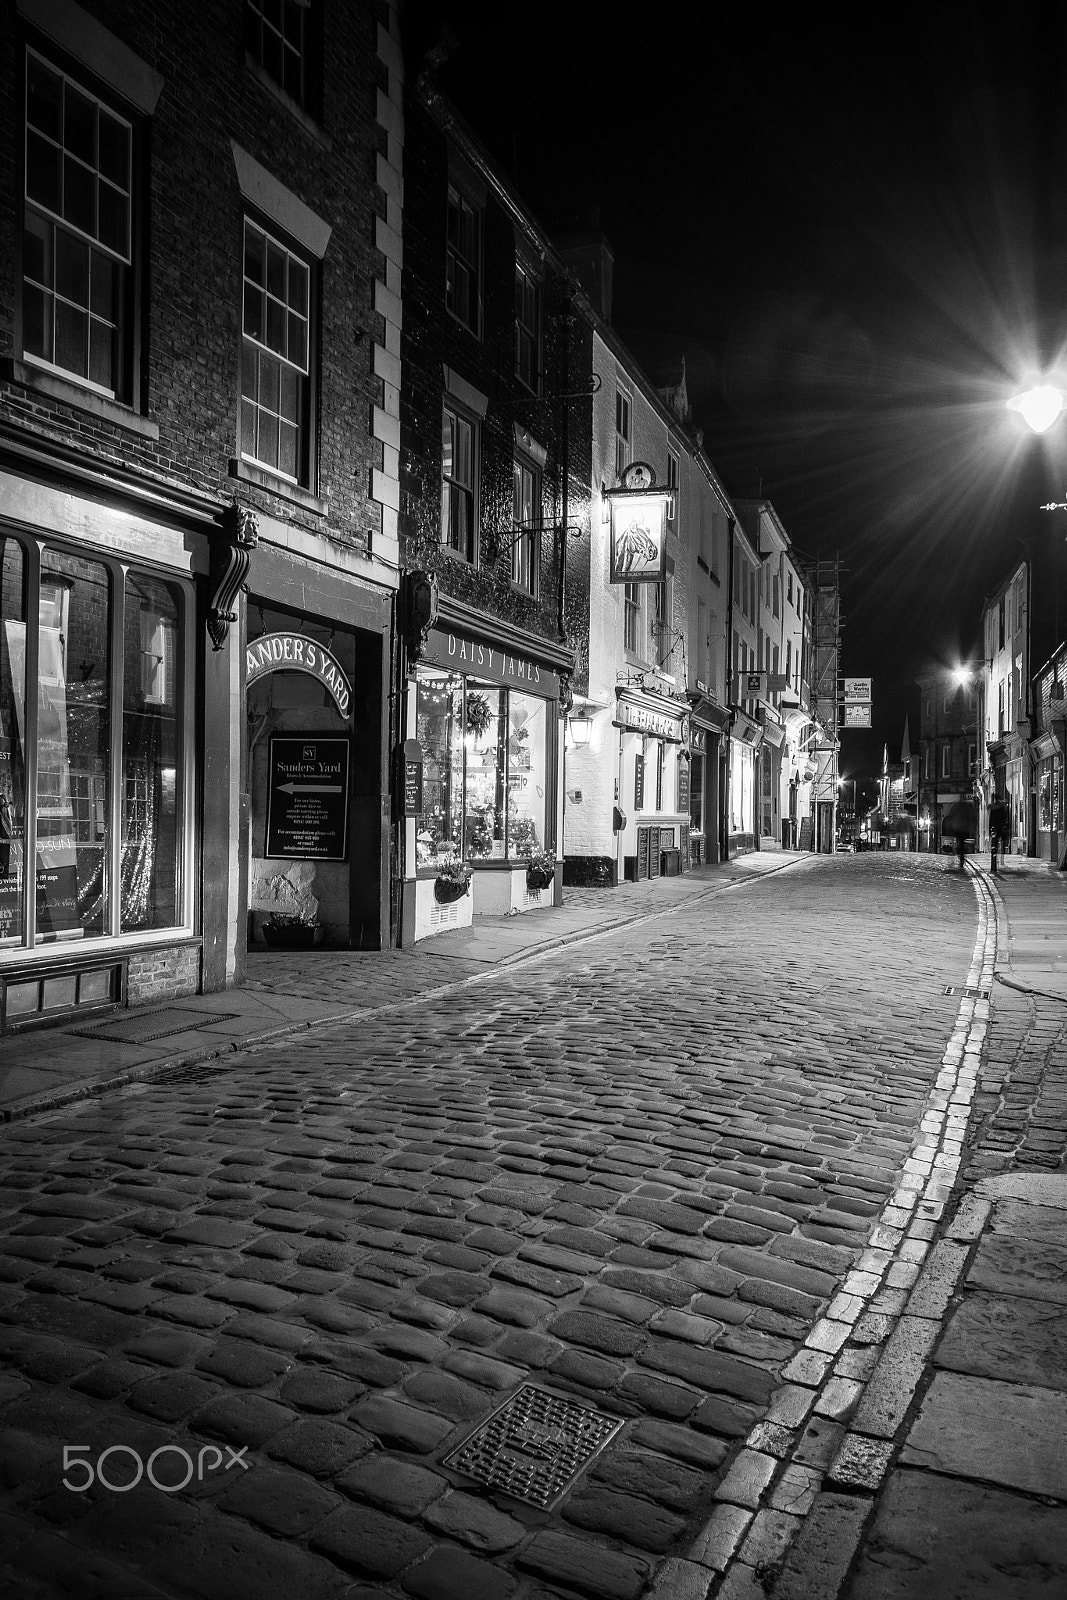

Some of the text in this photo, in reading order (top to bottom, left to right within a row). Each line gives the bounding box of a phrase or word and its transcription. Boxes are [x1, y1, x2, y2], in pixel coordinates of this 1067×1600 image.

[448, 633, 541, 683] DAISY JAMES
[246, 637, 350, 710] ANDER'S YARD
[277, 762, 341, 773] Sanders Yard
[304, 749, 315, 758] SY
